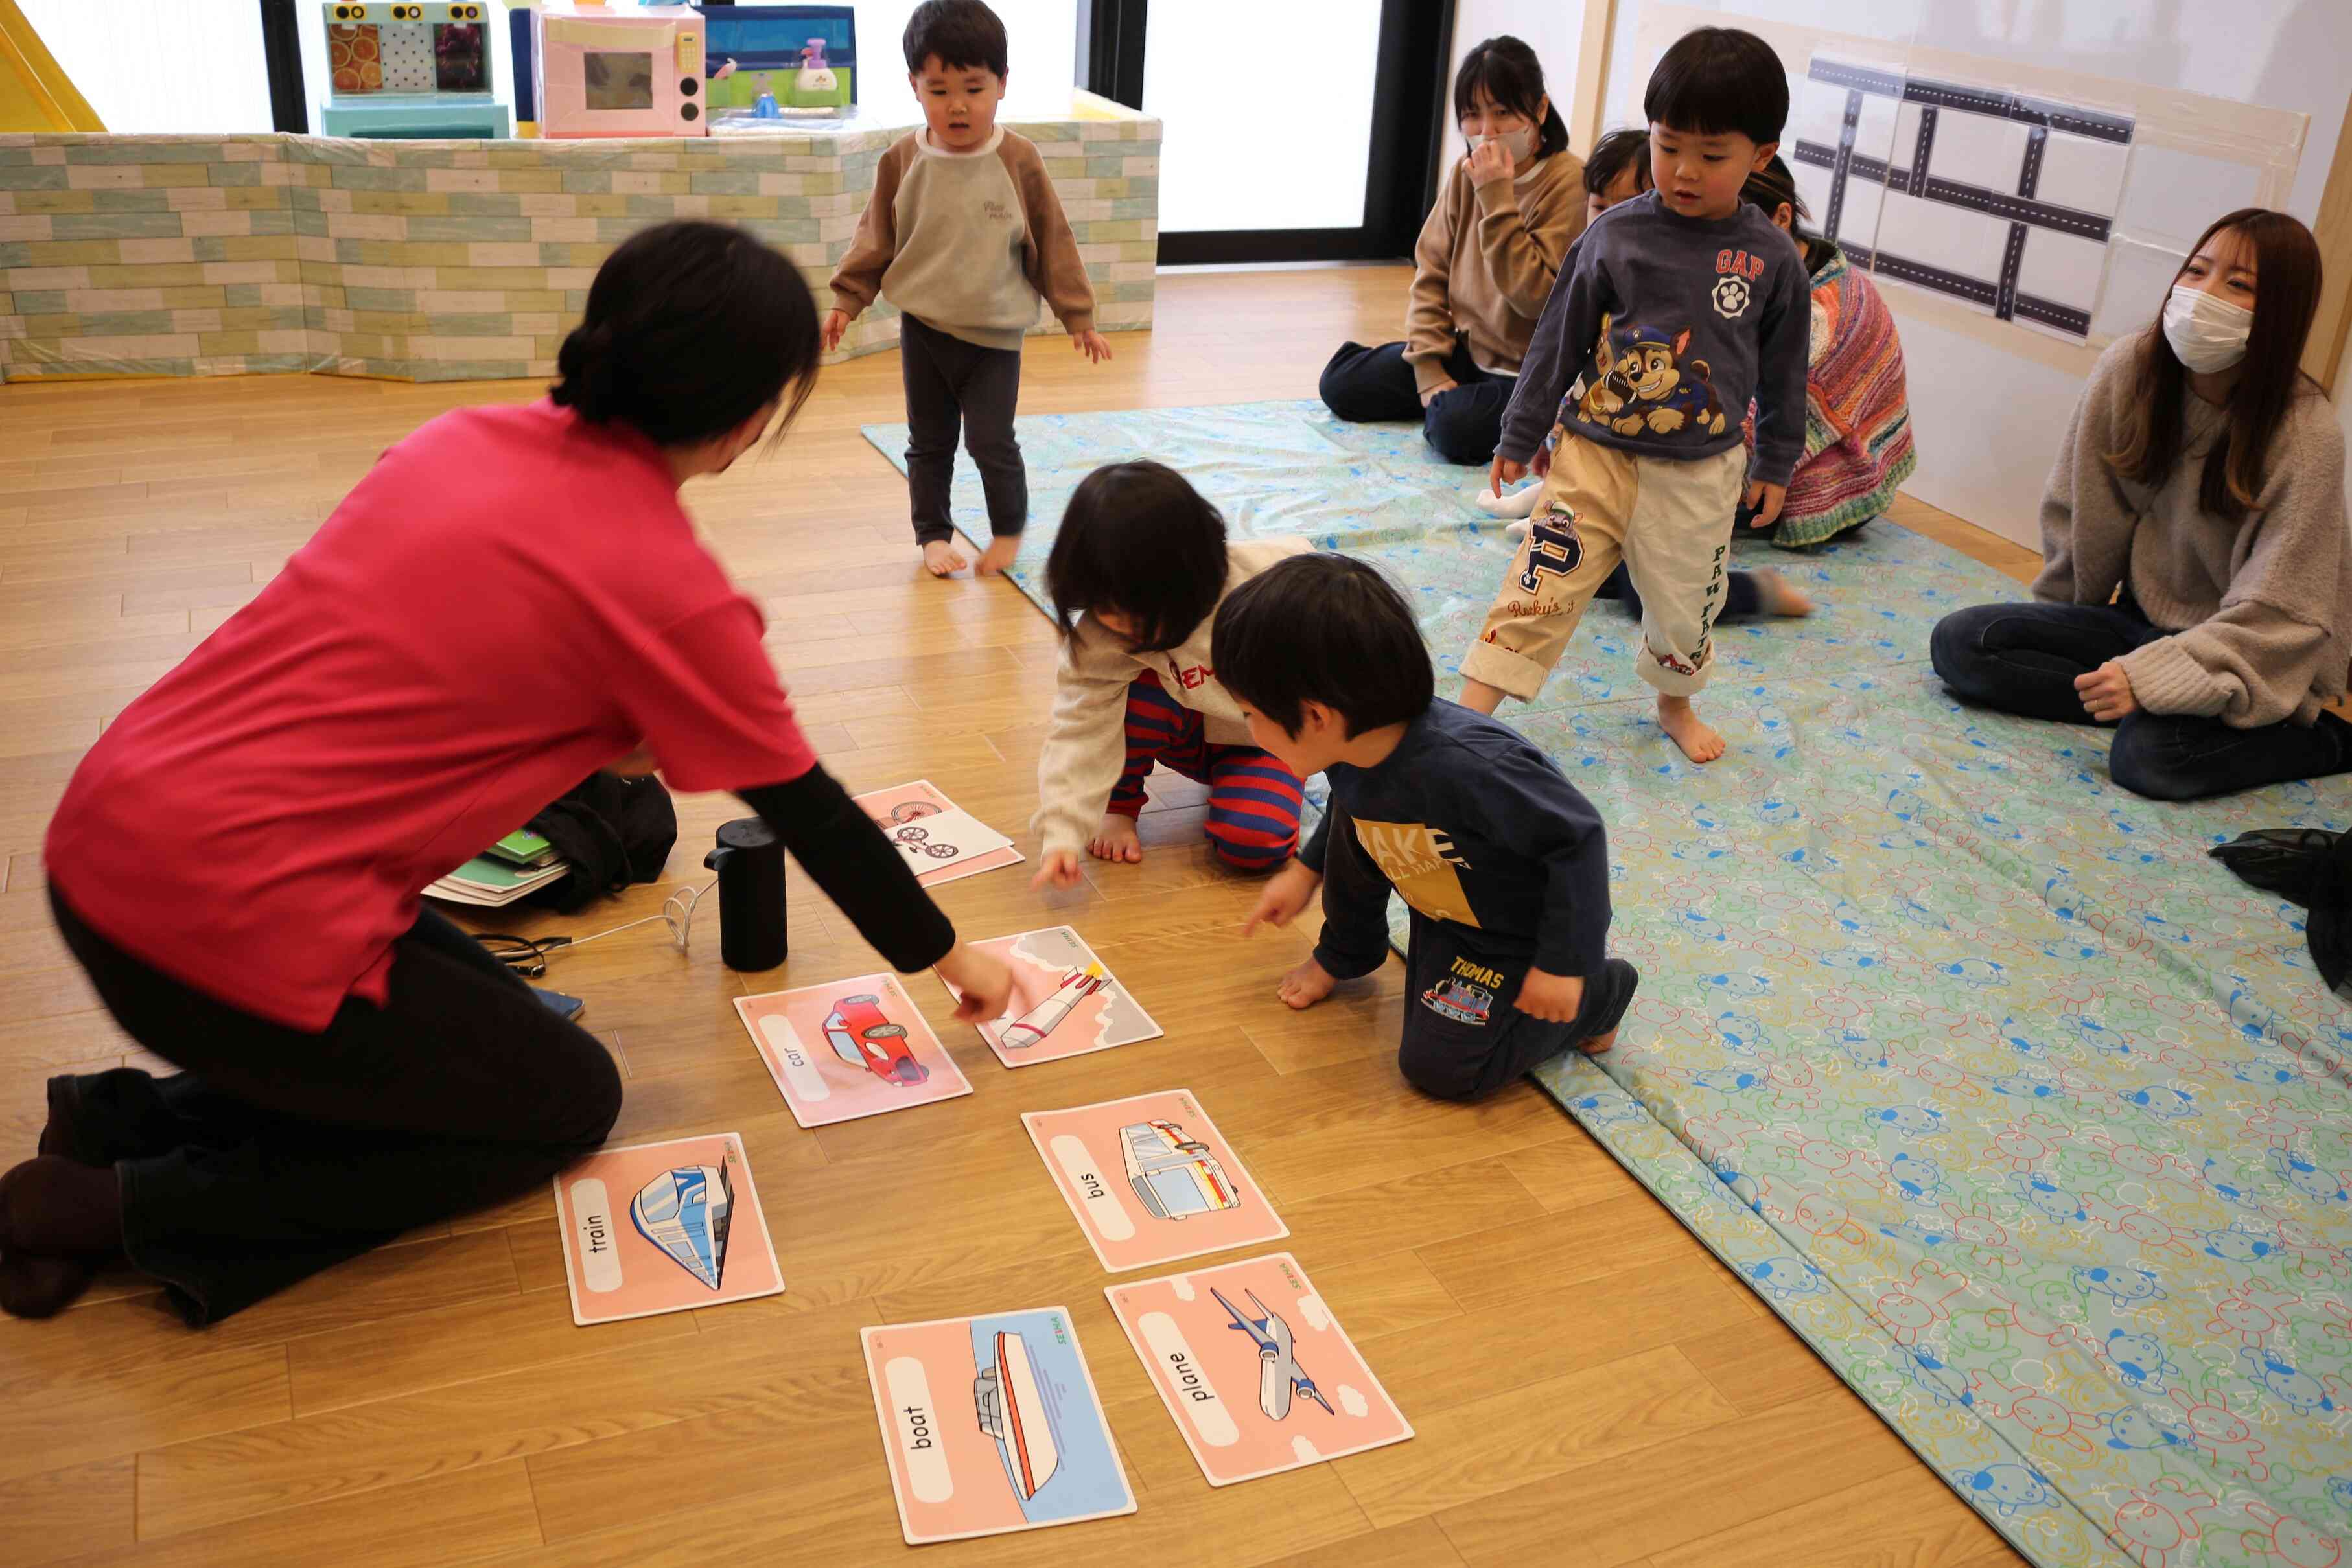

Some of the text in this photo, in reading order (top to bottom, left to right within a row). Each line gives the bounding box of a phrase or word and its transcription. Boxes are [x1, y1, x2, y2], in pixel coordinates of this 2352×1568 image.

[1716, 249, 1764, 281] GAP
[1450, 955, 1504, 989] THOMAS
[784, 1047, 804, 1067] car
[1080, 1172, 1106, 1200] bus
[583, 1214, 608, 1255] train
[1049, 1315, 1067, 1345] SEIHA
[1169, 1352, 1215, 1403] plane
[902, 1405, 933, 1451] boat
